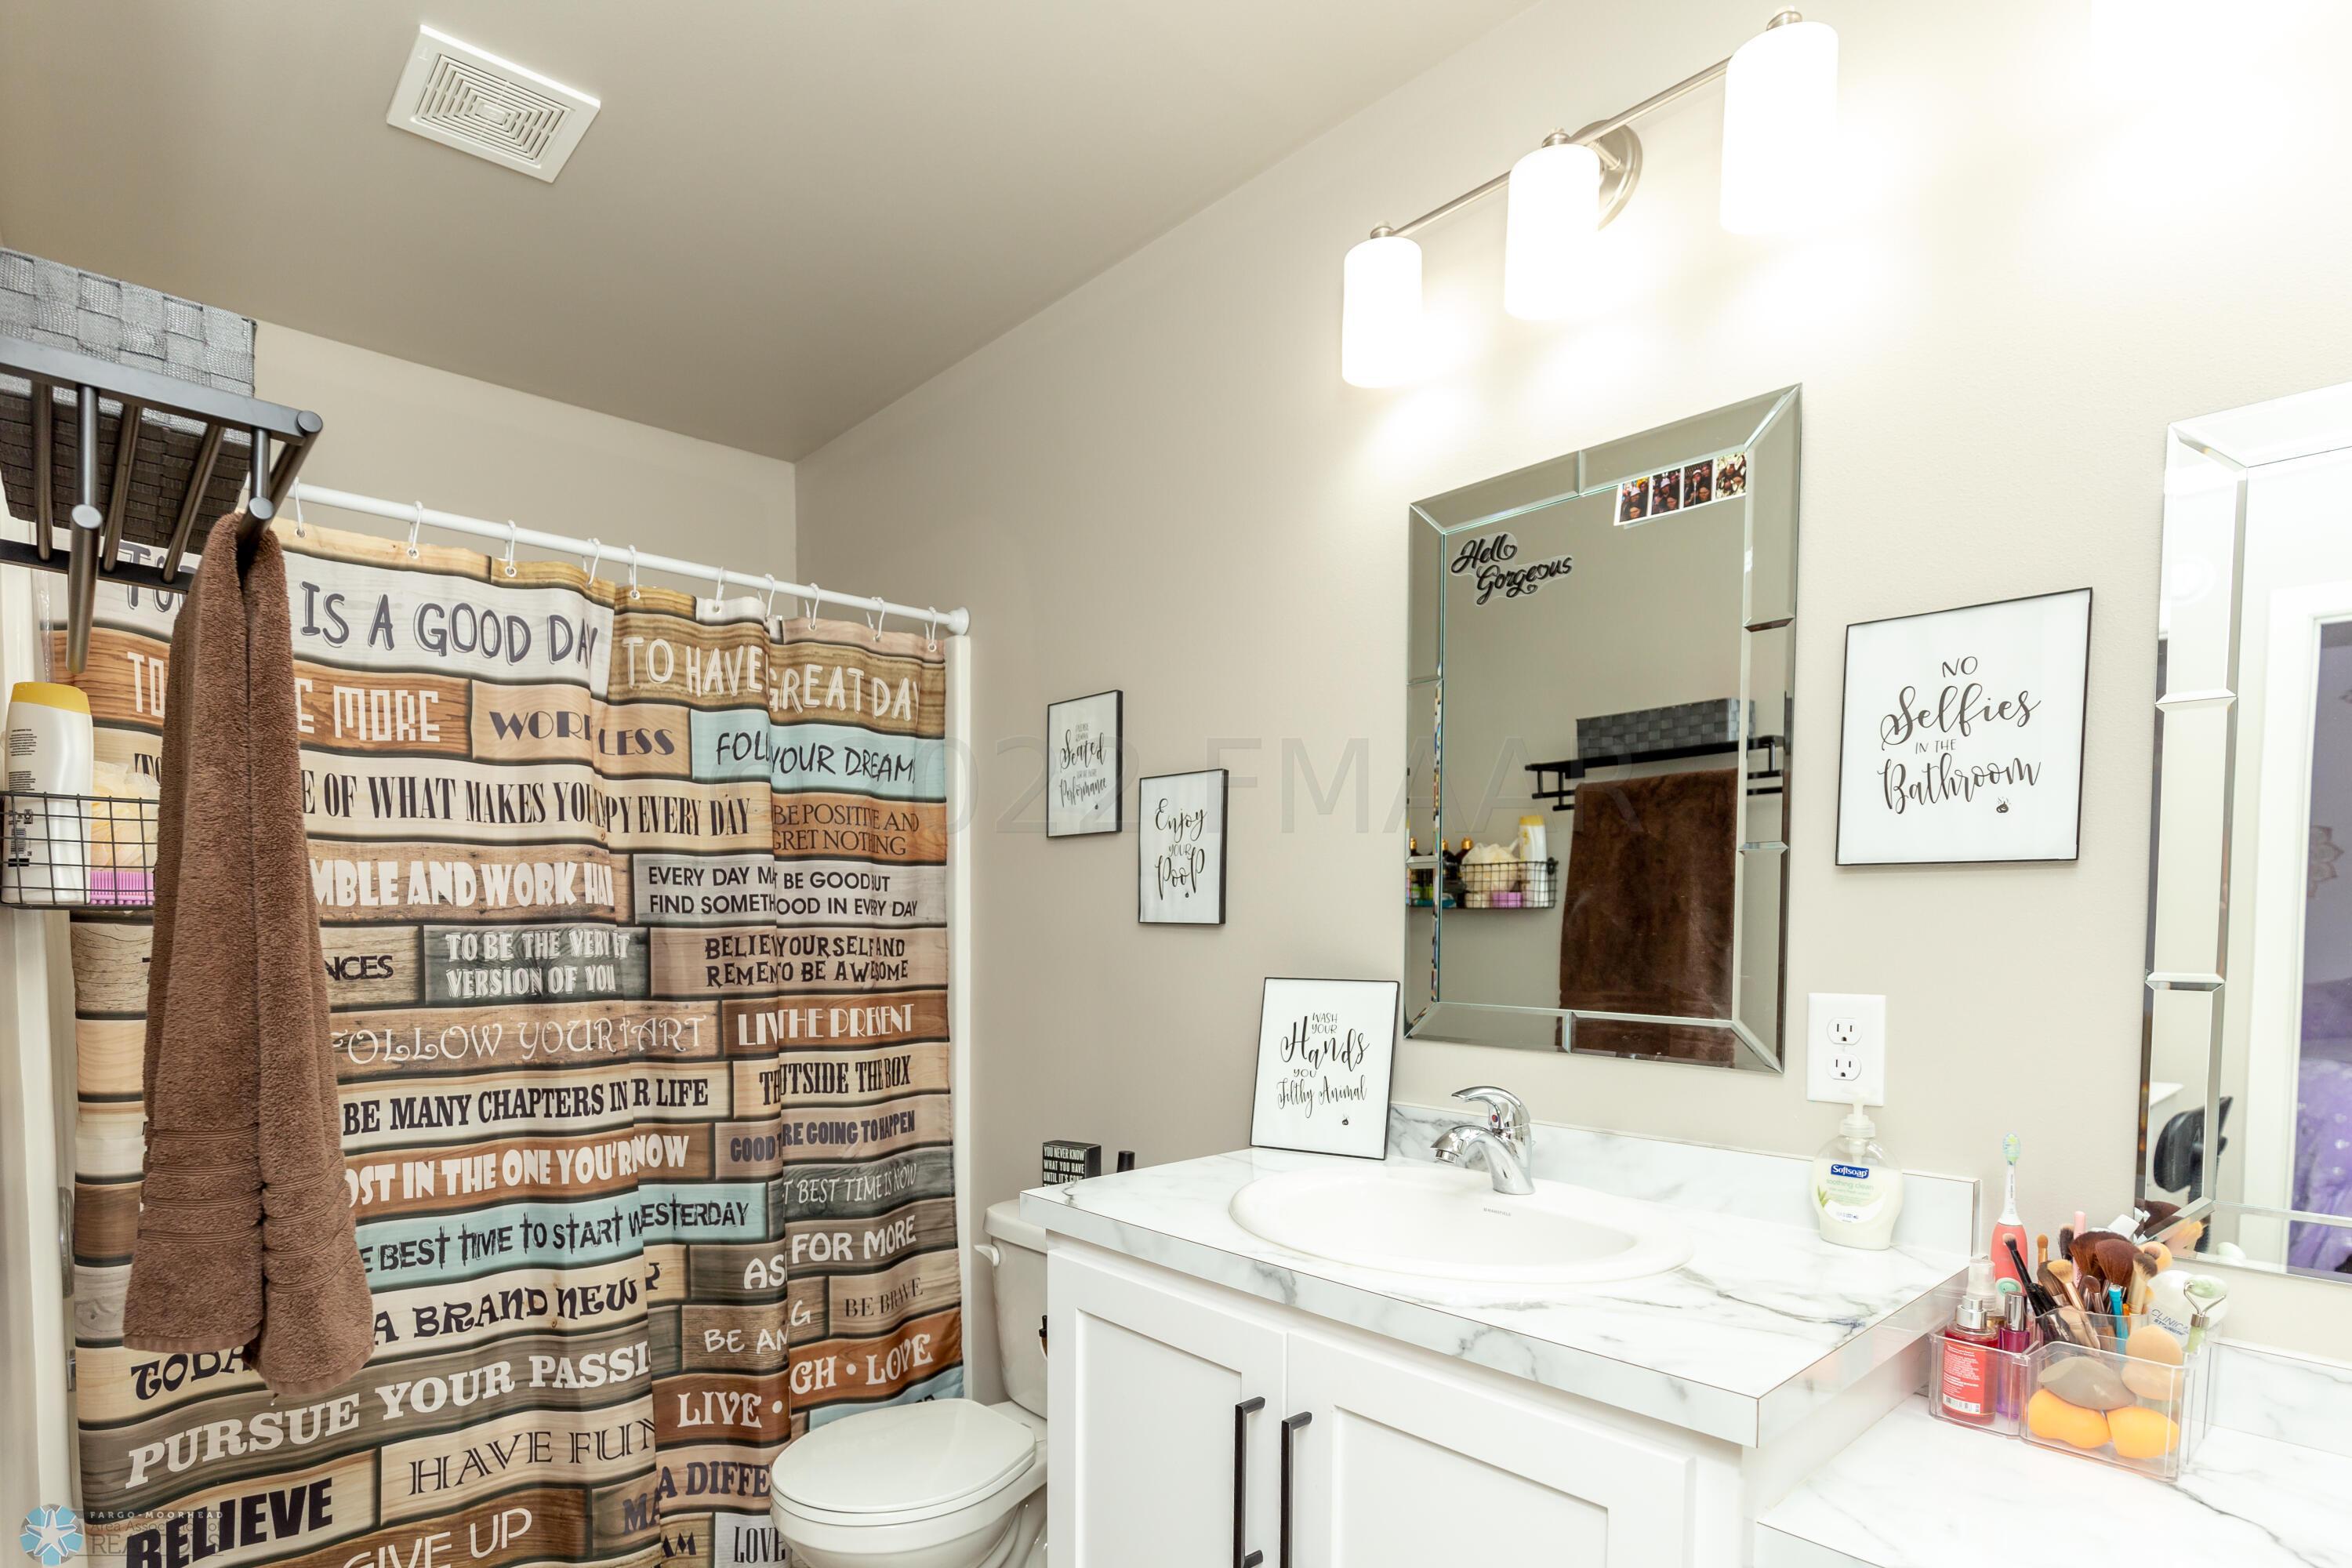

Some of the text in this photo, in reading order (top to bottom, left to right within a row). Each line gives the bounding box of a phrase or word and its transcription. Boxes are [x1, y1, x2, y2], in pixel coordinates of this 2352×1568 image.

[1450, 533, 1518, 574] Hello
[1475, 556, 1573, 605] Gorgeous
[299, 580, 350, 648] IS
[368, 593, 394, 651] A
[413, 602, 532, 666] GOOD
[622, 636, 676, 690] TO
[684, 644, 765, 698] HAVE
[1941, 655, 1979, 678] NO
[333, 685, 441, 743] MORE
[1880, 682, 2042, 751] Selfies
[598, 728, 675, 757] LESS
[770, 742, 837, 775] YOUR
[1060, 729, 1107, 772] Seated
[1915, 739, 1957, 755] IN THE
[1877, 752, 2042, 815] Bathroom
[324, 772, 358, 818] OF
[366, 776, 456, 820] WHAT
[465, 779, 545, 824] MAKES
[638, 796, 702, 836] EVERY
[709, 797, 750, 837] DAY
[803, 804, 880, 830] POSITIVE
[883, 811, 920, 833] AND
[1155, 798, 1207, 844] Enjoy
[822, 829, 907, 856] NOTHING
[1168, 844, 1192, 858] YOUR
[313, 859, 398, 906] MBLE
[407, 862, 477, 907] AND
[481, 862, 577, 907] WORK
[648, 866, 705, 887] EVERY
[712, 866, 750, 887] DAY
[784, 873, 804, 890] BE
[809, 871, 870, 890] GOOD
[650, 893, 918, 918] FIND SOMETH OOD IN EVERY DAY
[445, 932, 478, 962] TO
[483, 932, 514, 961] BE
[521, 930, 561, 960] THE
[568, 928, 611, 959] VERY
[876, 936, 906, 957] AND
[445, 964, 543, 999] VERSION
[548, 964, 579, 995] OF
[800, 960, 826, 982] BE
[833, 959, 909, 984] AWESOME
[829, 1004, 915, 1038] PRESENT
[1312, 1012, 1338, 1024] WASH
[1312, 1023, 1338, 1034] YOUR
[517, 1018, 616, 1060] YOUR
[1280, 1015, 1370, 1072] Hands
[780, 1062, 849, 1096] UTSIDE
[855, 1062, 883, 1092] THE
[884, 1055, 911, 1087] BOX
[1293, 1069, 1317, 1078] YOU
[343, 1100, 380, 1136] BE
[390, 1094, 472, 1130] MANY
[477, 1083, 604, 1123] CHAPTERS
[609, 1080, 628, 1111] IN
[655, 1078, 710, 1107] LIFE
[1276, 1074, 1368, 1119] Filthy Animal
[730, 1136, 775, 1163] GOOD
[806, 1121, 858, 1145] GOING
[861, 1119, 879, 1142] TO
[879, 1110, 915, 1139] HAPPEN
[1044, 1146, 1086, 1161] YOU NEVER KNOW
[402, 1160, 434, 1199] IN
[441, 1153, 497, 1196] THE
[502, 1149, 551, 1187] ONE
[795, 1178, 841, 1204] BEST
[844, 1174, 883, 1202] TIME
[894, 1163, 916, 1192] NOW
[1044, 1160, 1085, 1174] WHAT YOU HAVE
[1832, 1165, 1868, 1178] Softsoap
[379, 1225, 450, 1270] BEST
[458, 1222, 514, 1263] TIME
[519, 1211, 548, 1254] TO
[552, 1205, 623, 1254] START
[791, 1232, 853, 1265] FOR
[863, 1214, 917, 1259] MORE
[412, 1287, 550, 1338] BRAND
[557, 1276, 637, 1320] NEW
[844, 1298, 873, 1318] BE
[880, 1276, 924, 1313] BRAVE
[704, 1328, 746, 1353] BE
[677, 1391, 762, 1428] LIVE
[866, 1333, 933, 1385] LOVE
[125, 1340, 652, 1490] PURSUE YOUR PASSI
[408, 1417, 655, 1496] HAVE FUN
[684, 1461, 771, 1498] DIFFE
[125, 1477, 333, 1568] BELIEVE
[470, 1508, 532, 1559] UP
[732, 1526, 786, 1564] LOVE
